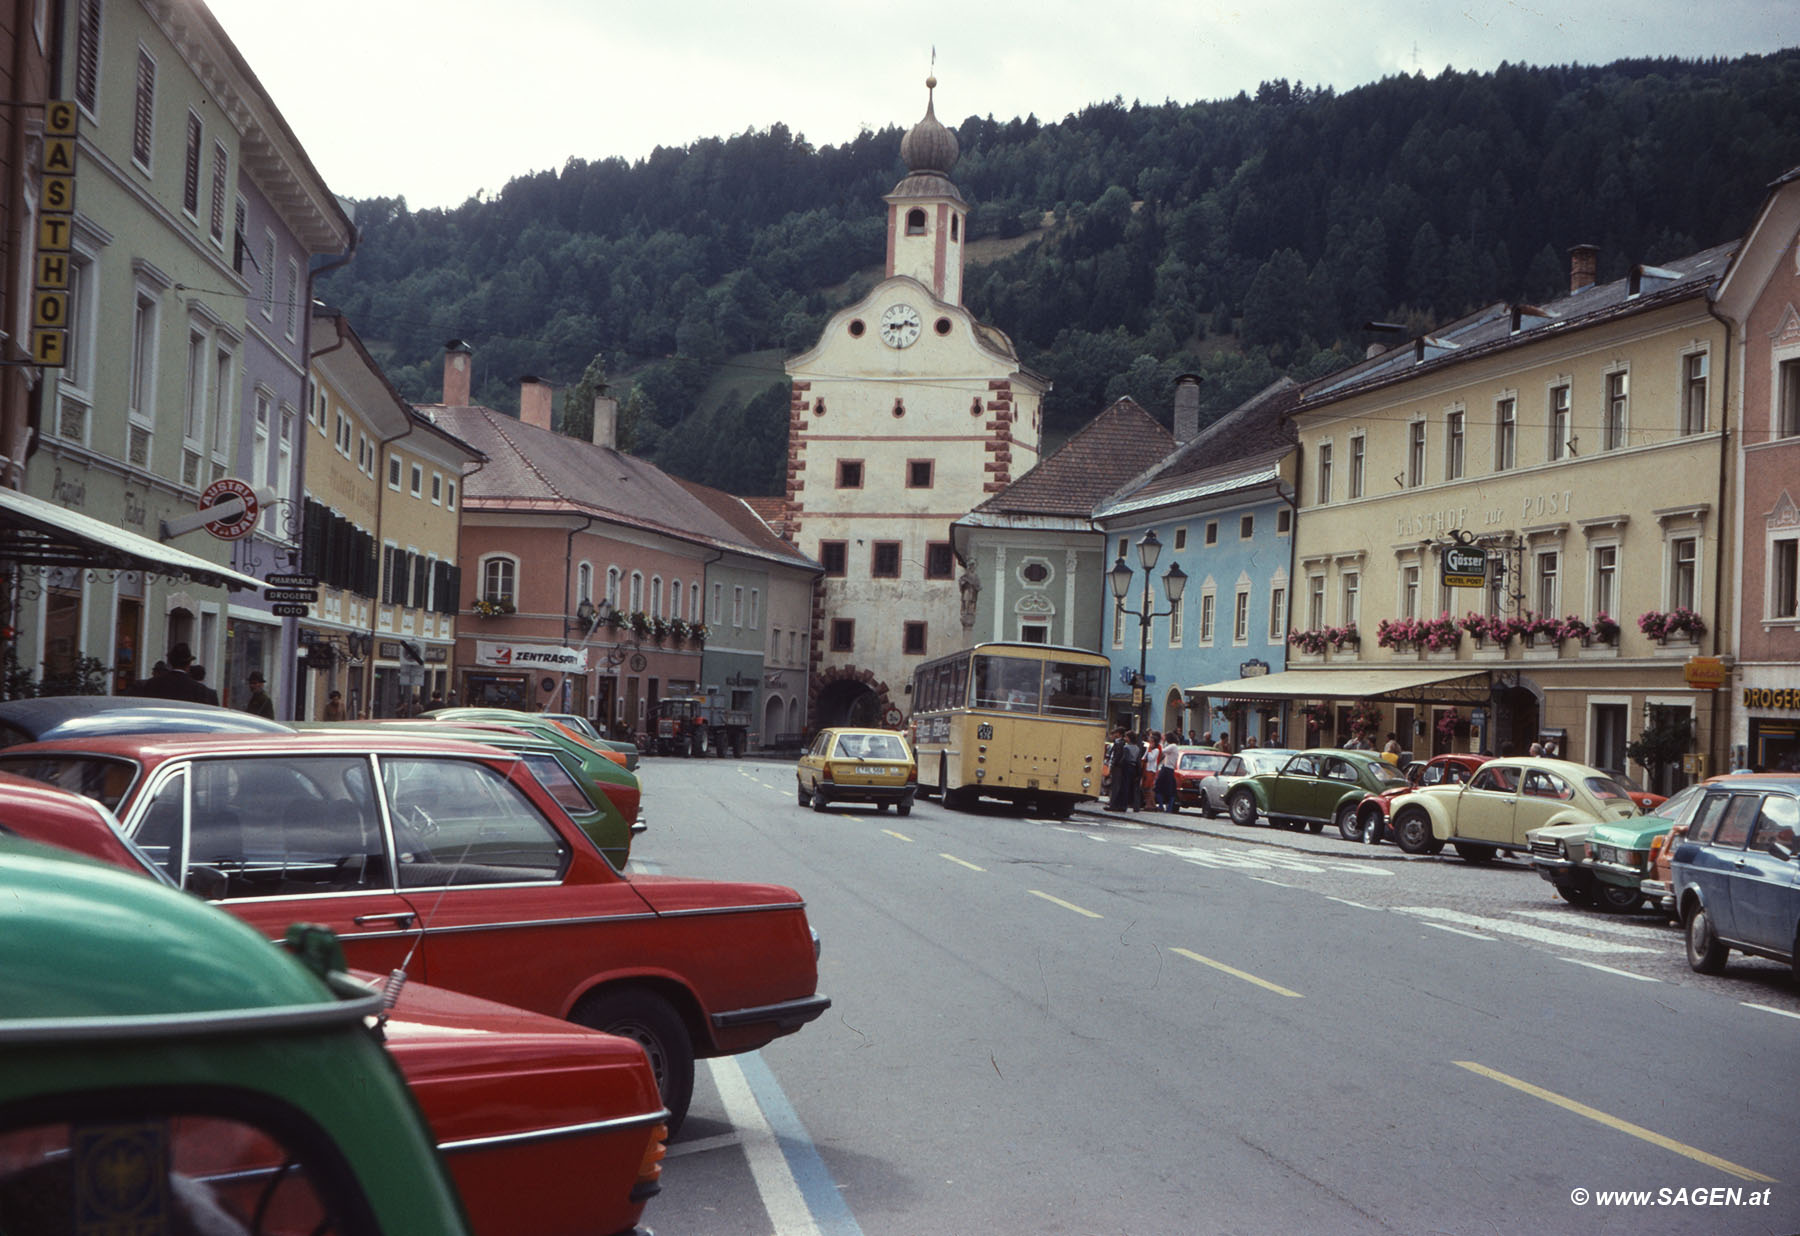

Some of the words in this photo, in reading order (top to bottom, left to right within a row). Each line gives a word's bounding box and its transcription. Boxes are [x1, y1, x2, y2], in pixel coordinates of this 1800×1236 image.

[40, 105, 70, 359] GASTHOF
[203, 481, 256, 507] AUSTRIA
[1396, 506, 1468, 536] GASTHOF
[1522, 490, 1573, 519] POST
[1447, 550, 1483, 571] Gösser
[270, 592, 312, 600] DROGERIE
[1743, 688, 1800, 708] DROGER
